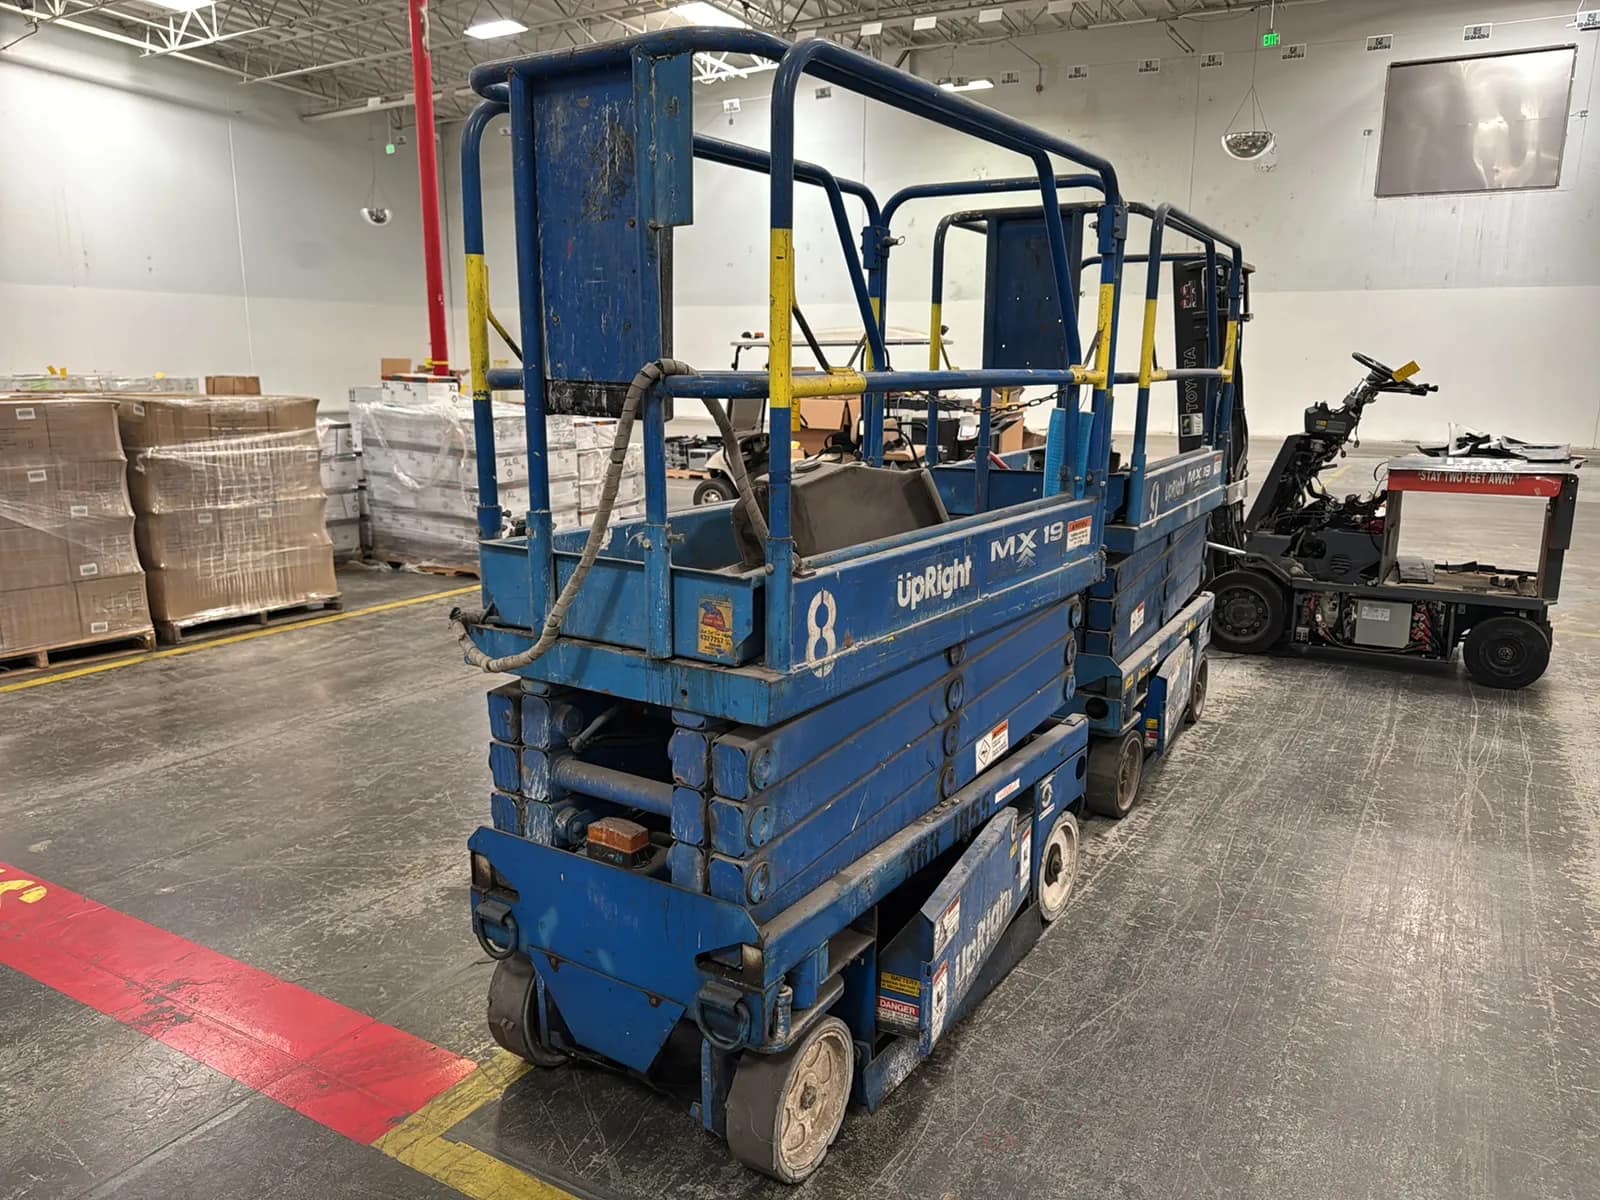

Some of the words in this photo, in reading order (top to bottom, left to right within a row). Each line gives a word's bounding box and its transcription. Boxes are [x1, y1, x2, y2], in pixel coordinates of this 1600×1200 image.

[1183, 346, 1199, 413] TOYTA
[1444, 471, 1463, 483] TWO
[1465, 472, 1486, 484] FEET
[897, 555, 973, 610] UpRight
[990, 528, 1037, 562] MX
[1043, 521, 1065, 545] 19
[805, 588, 837, 679] 8
[880, 999, 916, 1015] DANGER
